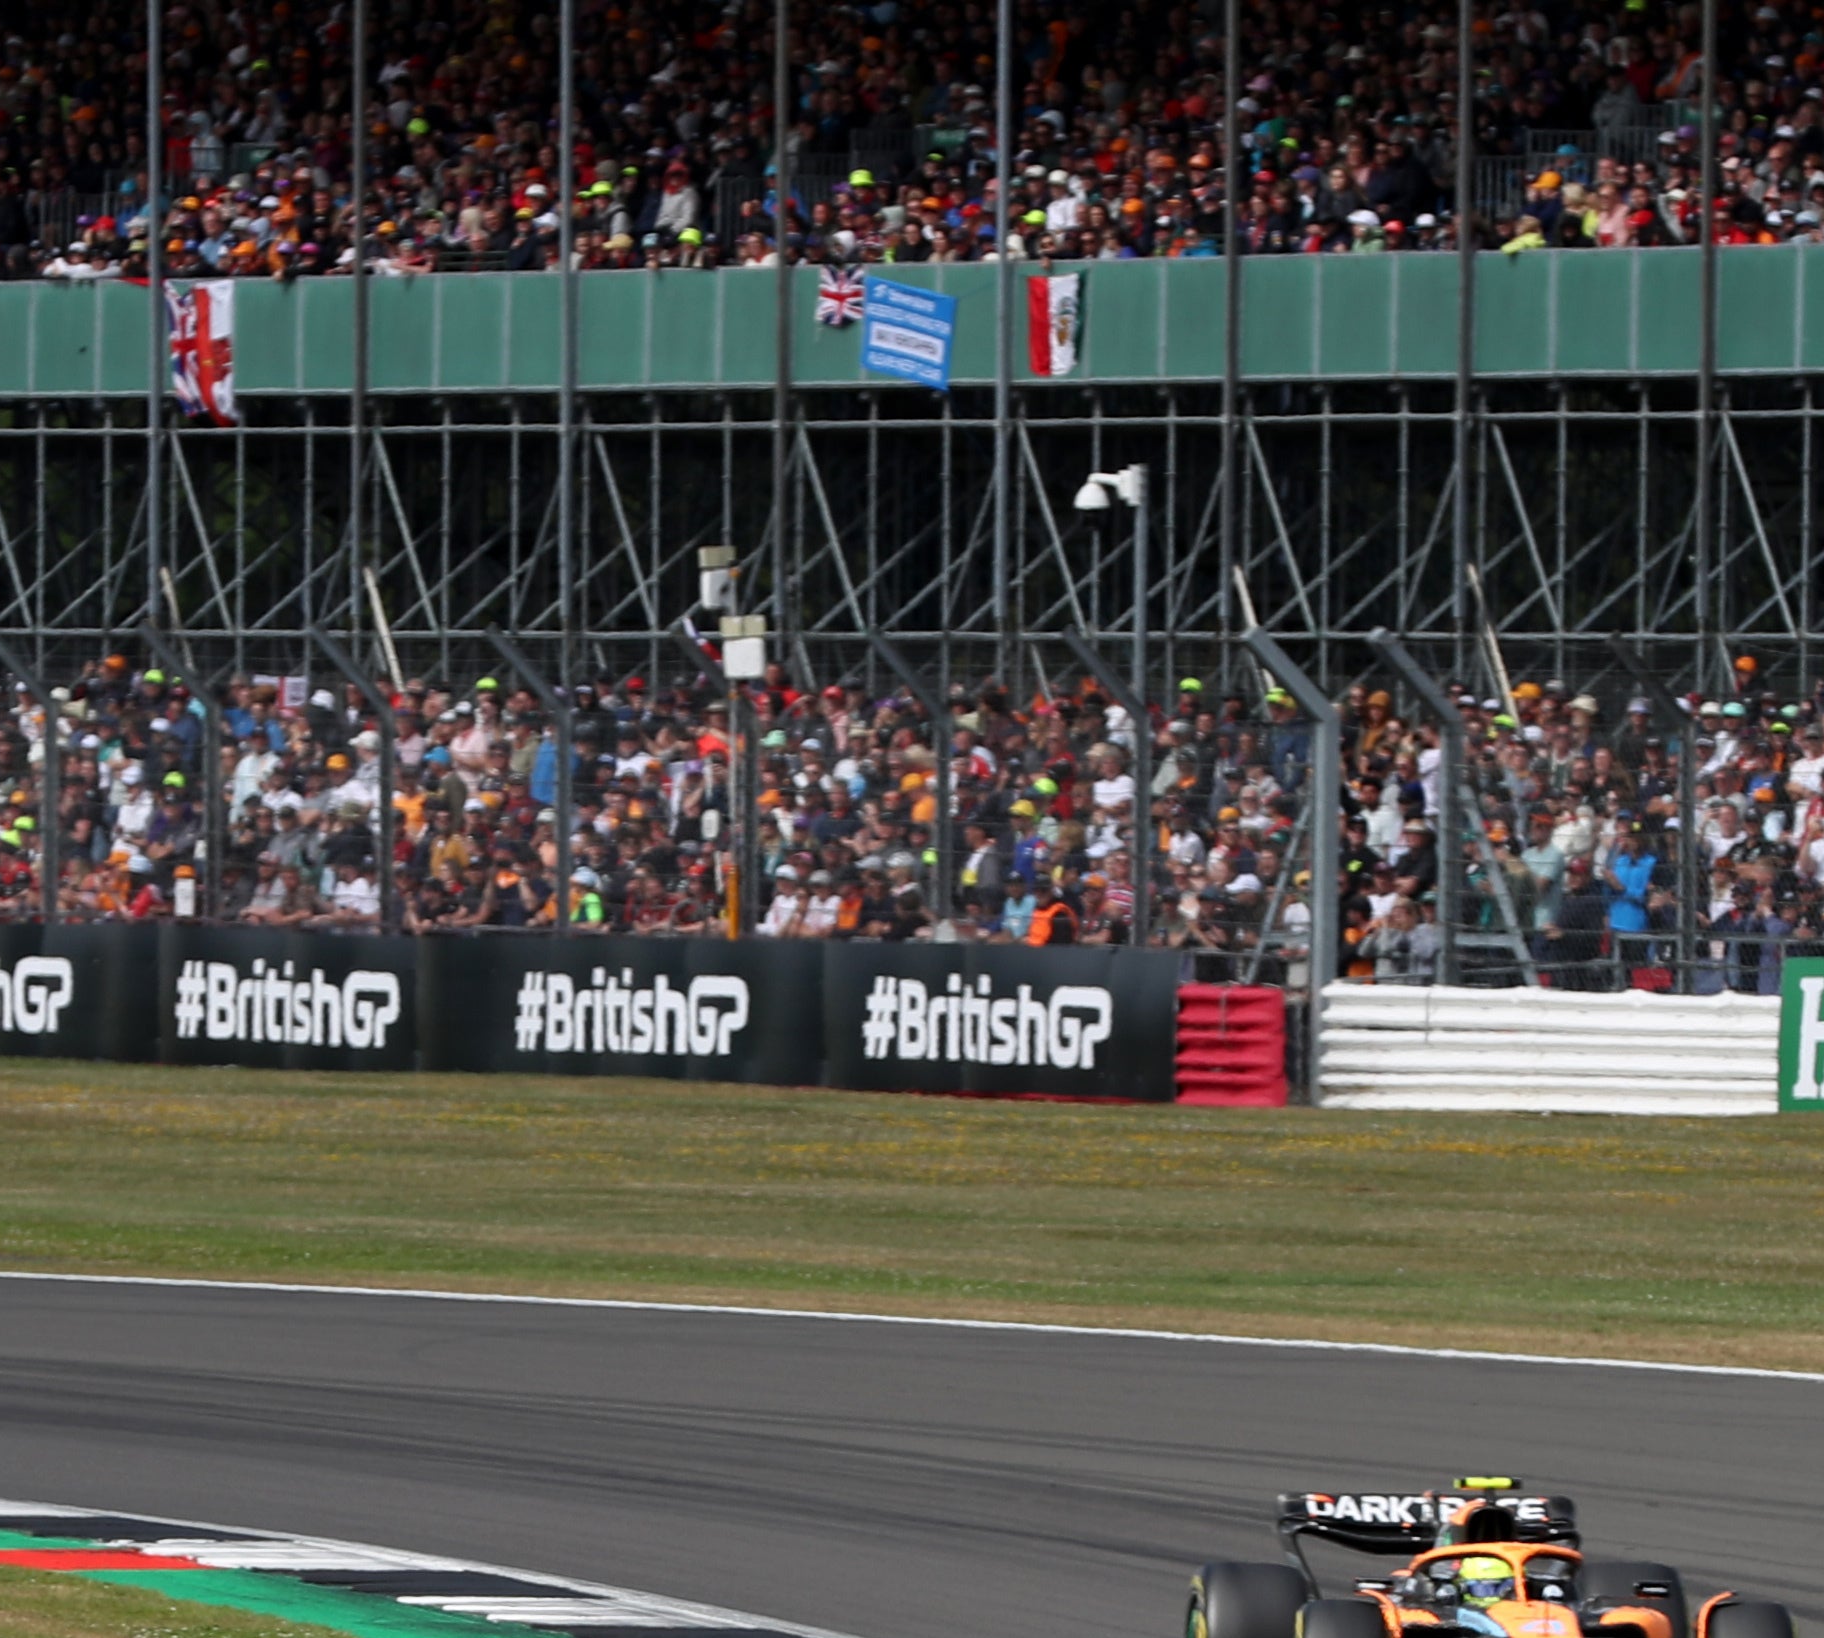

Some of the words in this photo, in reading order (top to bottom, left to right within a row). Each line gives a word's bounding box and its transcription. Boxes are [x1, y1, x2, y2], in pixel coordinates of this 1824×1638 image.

[175, 959, 400, 1049] #BritishGP
[515, 966, 748, 1055] #BritishGP
[863, 973, 1112, 1069] #BritishGP
